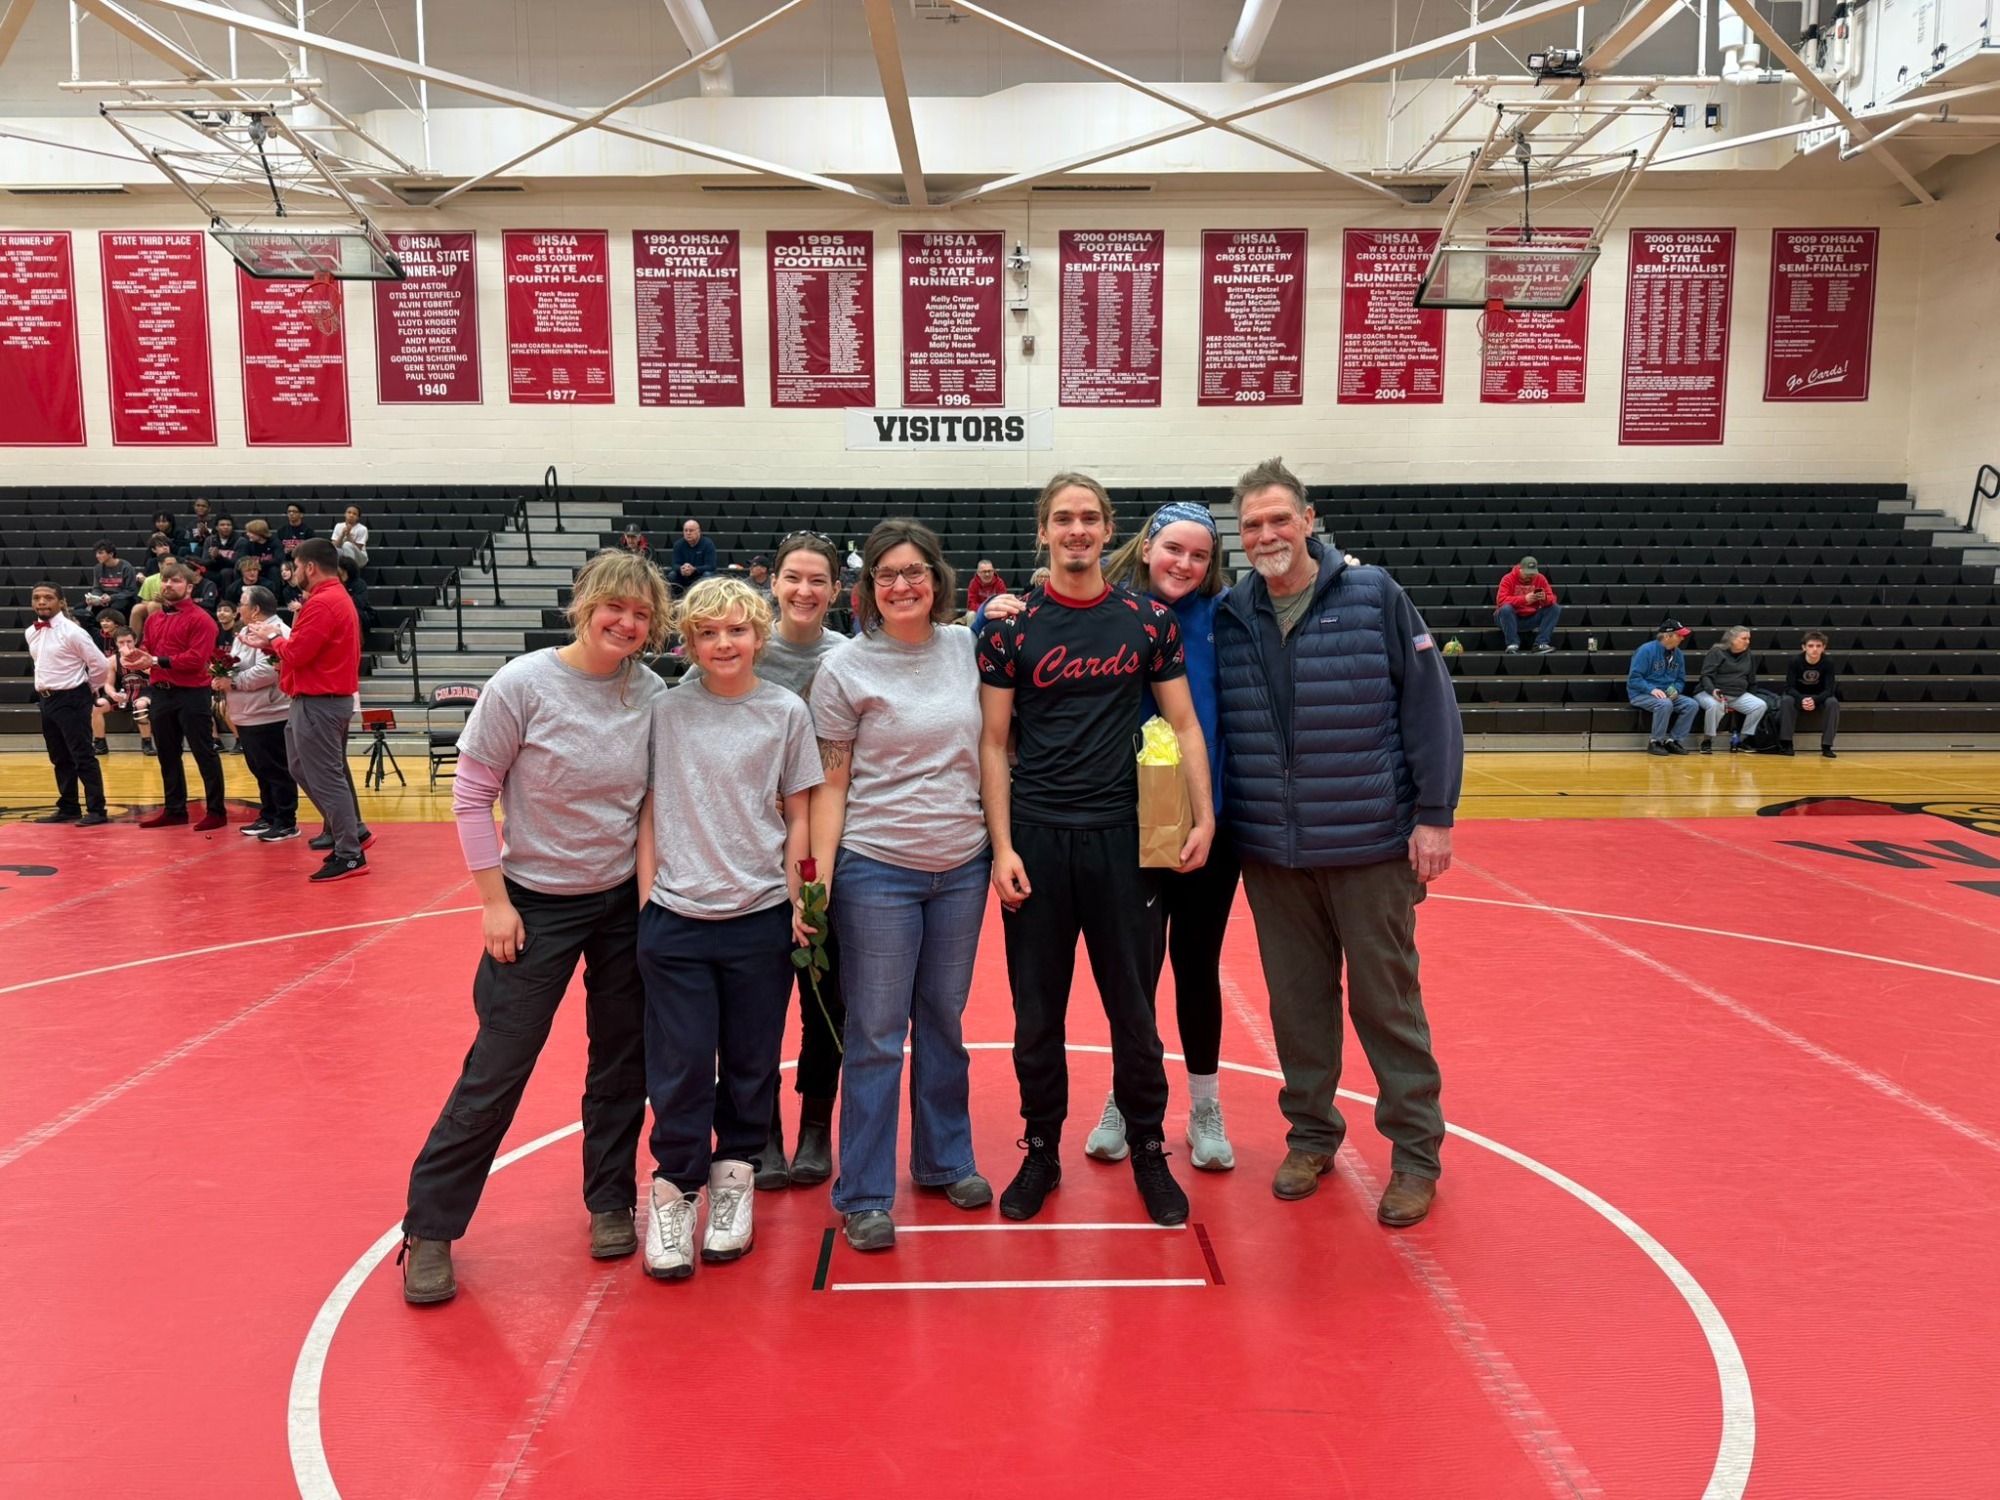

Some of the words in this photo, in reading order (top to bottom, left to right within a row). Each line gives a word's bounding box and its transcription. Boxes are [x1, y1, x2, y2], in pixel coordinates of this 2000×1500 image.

[9, 237, 53, 245] RUNNER-UP
[113, 236, 136, 245] STATE
[140, 237, 163, 245] THIRD
[166, 236, 190, 245] PLACE
[644, 235, 676, 244] 1994
[680, 235, 729, 244] OHSAA
[799, 236, 844, 244] 1995
[1074, 233, 1104, 241] 2000
[1108, 233, 1152, 241] OHSAA
[1645, 235, 1673, 243] 2006
[1678, 235, 1720, 243] OHSAA
[650, 246, 722, 255] FOOTBALL
[775, 247, 864, 255] COLERAIN
[1079, 243, 1147, 251] FOOTBALL
[1650, 245, 1714, 253] FOOTBALL
[1793, 245, 1857, 253] SOFTBALL
[400, 251, 433, 263] EBALL
[437, 250, 469, 262] STATE
[1093, 253, 1132, 261] STATE
[1806, 254, 1843, 262] STATE
[665, 257, 708, 266] STATE
[775, 257, 866, 266] FOOTBALL
[402, 265, 457, 277] NNER-UP
[535, 265, 577, 273] STATE
[1066, 263, 1160, 271] SEMI-FINALIST
[1233, 264, 1274, 272] STATE
[1374, 264, 1416, 272] STATE
[1518, 264, 1560, 272] STATE
[1636, 265, 1725, 273] SEMI-FINALIST
[636, 269, 737, 277] SEMI-FINALIST
[930, 267, 975, 276] STATE
[509, 275, 559, 283] FOURTH
[910, 277, 994, 285] RUNNER-UP
[1214, 275, 1293, 283] RUNNER-UP
[1354, 274, 1425, 282] RUNNER-U
[410, 291, 460, 299] BUTTERFIELD
[1787, 375, 1803, 391] Go
[1808, 360, 1849, 384] Cards!
[418, 384, 446, 395] 1940
[1518, 389, 1548, 398] 2005
[546, 390, 576, 400] 1977
[1235, 391, 1265, 401] 2003
[1375, 389, 1406, 399] 2004
[937, 395, 970, 405] 1996
[874, 416, 1024, 442] VISITORS
[1033, 643, 1140, 688] Cards
